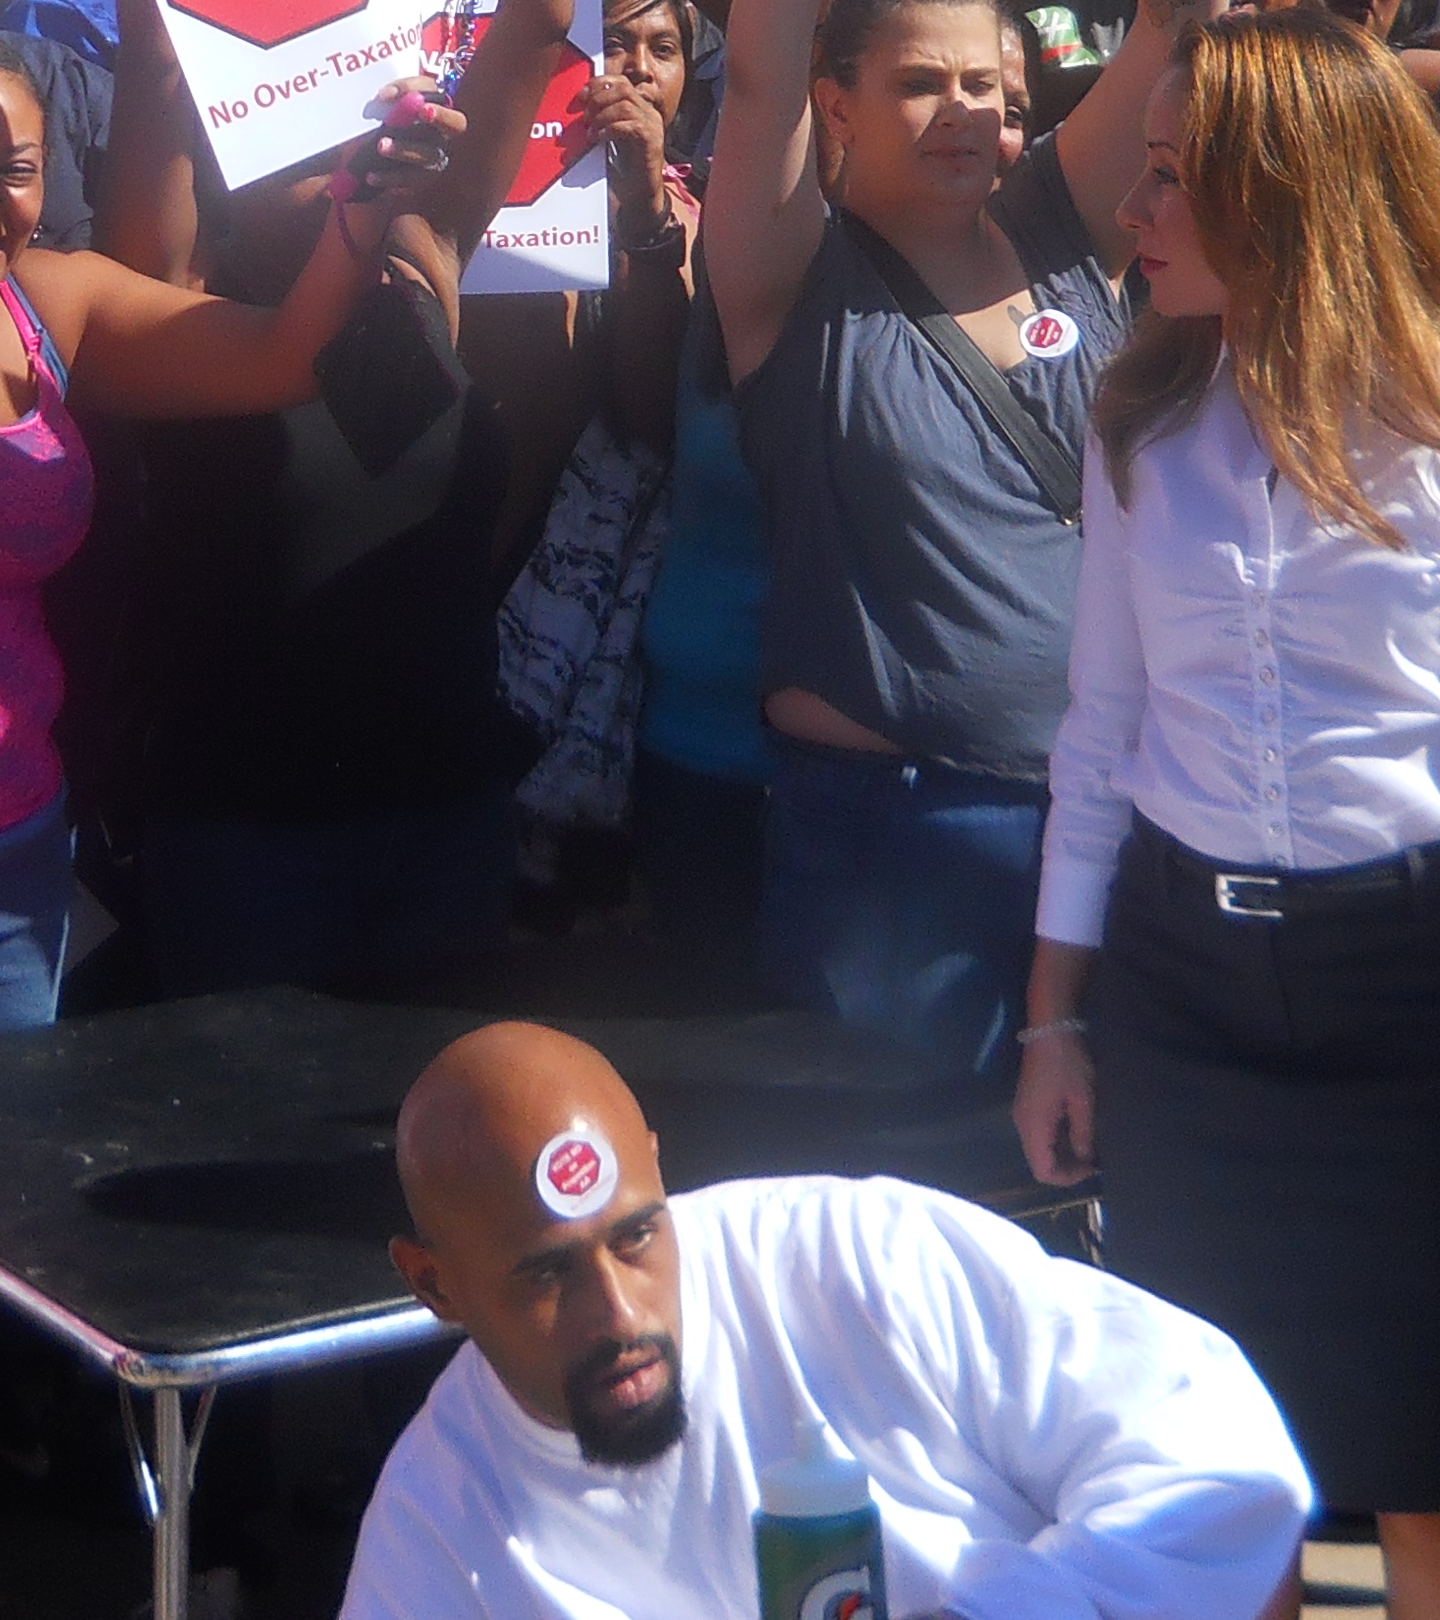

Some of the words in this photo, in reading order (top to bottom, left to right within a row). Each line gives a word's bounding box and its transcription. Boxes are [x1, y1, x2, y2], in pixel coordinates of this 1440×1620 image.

[207, 98, 249, 129] No
[253, 12, 422, 110] Over-Taxation
[484, 225, 600, 249] Taxation!
